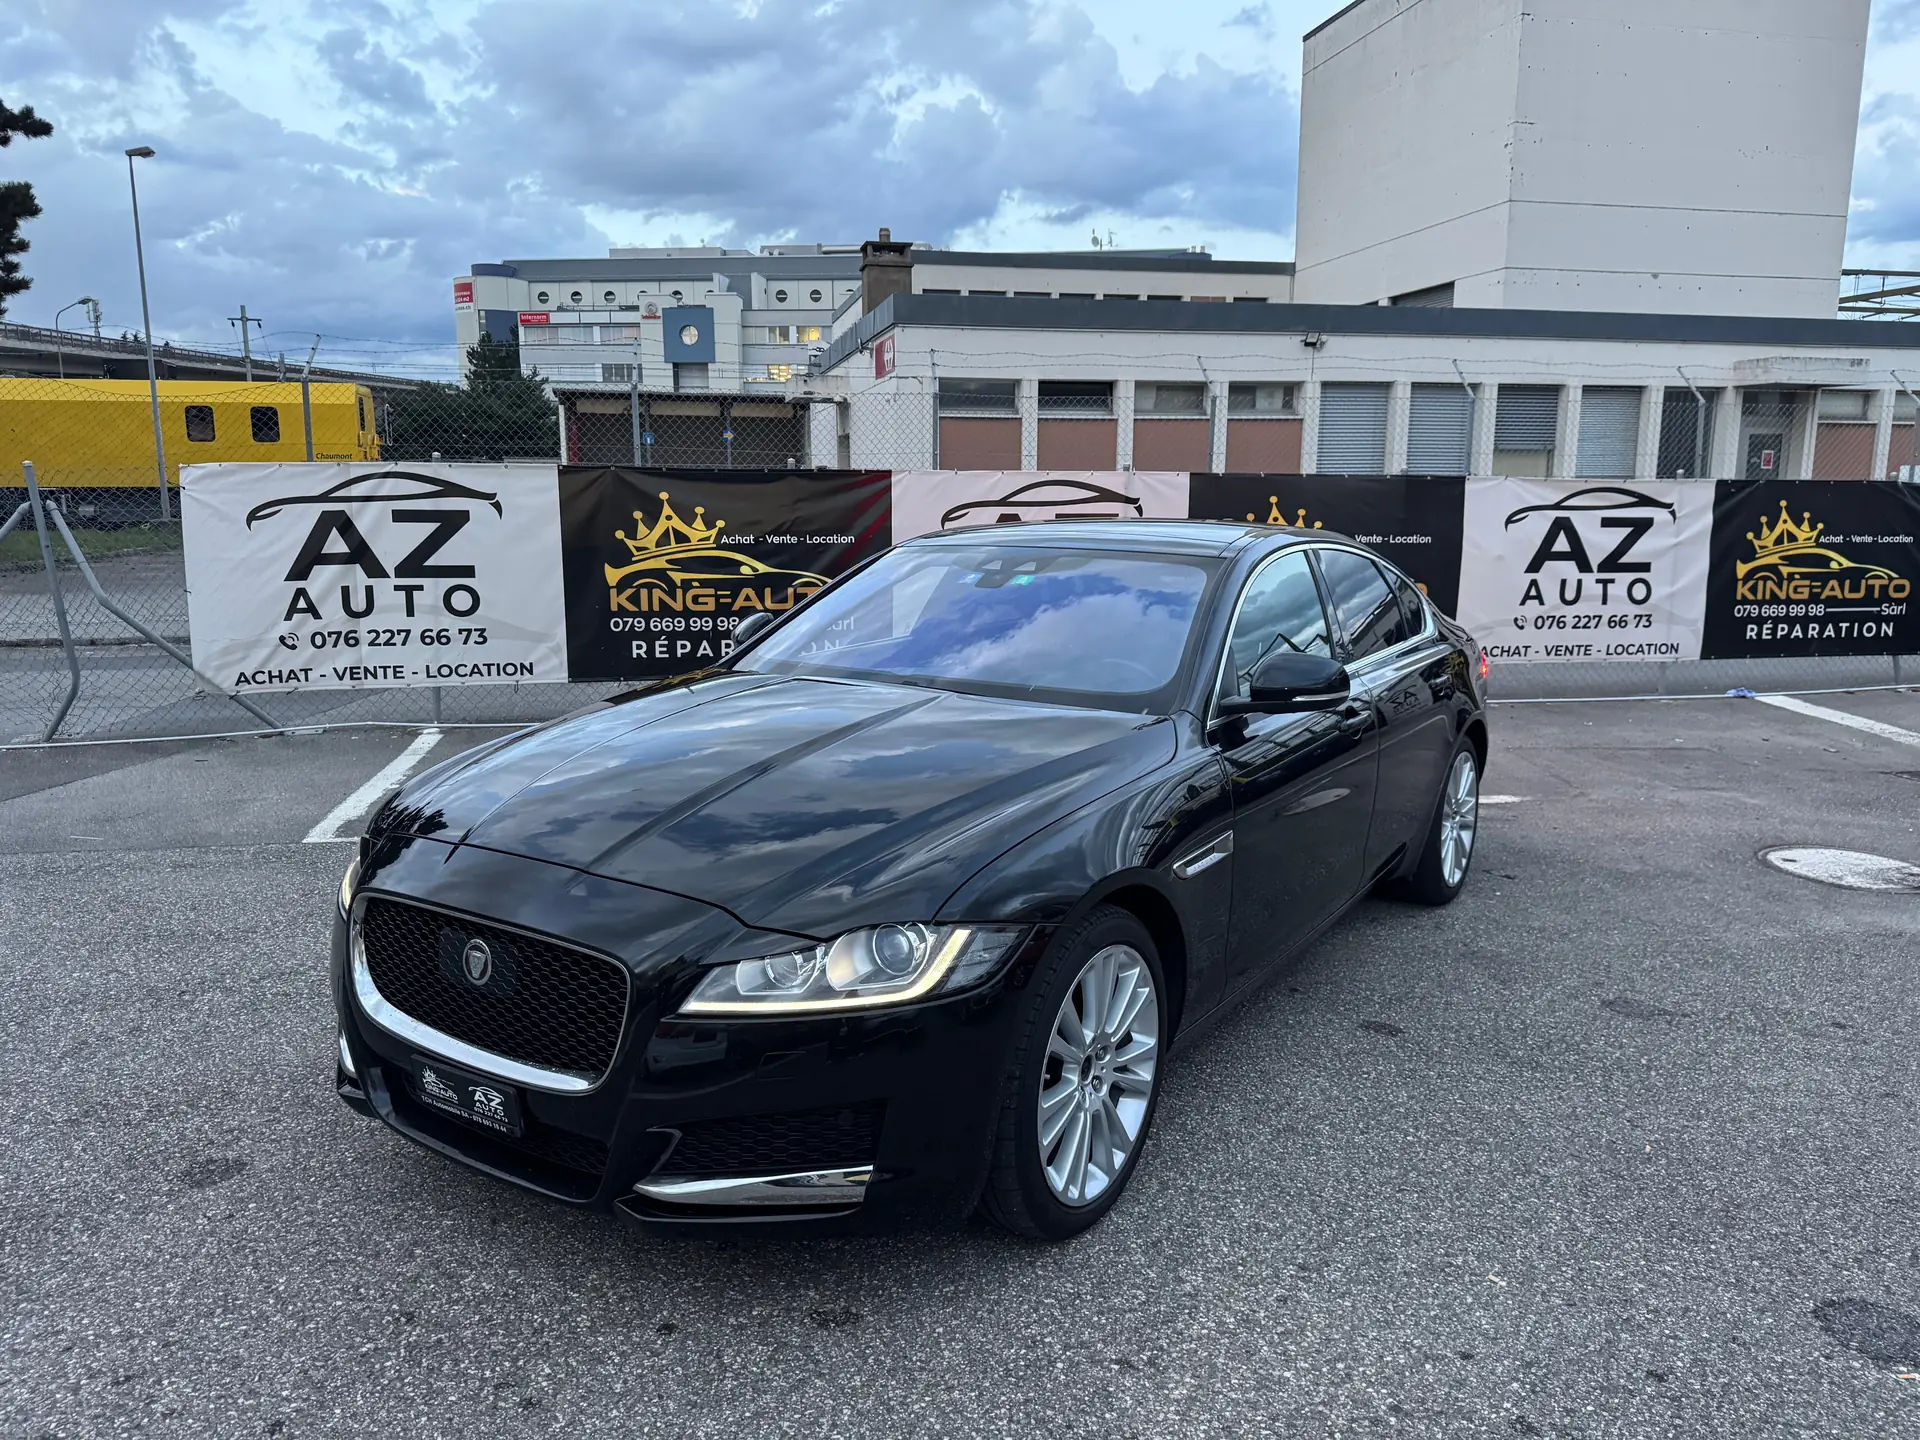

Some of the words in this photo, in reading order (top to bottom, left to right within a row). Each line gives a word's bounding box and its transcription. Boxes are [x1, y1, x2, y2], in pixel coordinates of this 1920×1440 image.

[315, 452, 353, 460] Chaumont
[284, 509, 476, 581] AZ
[721, 533, 755, 545] Achat
[765, 534, 798, 545] Vente
[806, 534, 855, 545] Location
[1355, 534, 1383, 543] Vente
[1390, 534, 1431, 543] Location
[1524, 516, 1654, 573] AZ
[1819, 534, 1843, 543] Achat
[1851, 535, 1873, 543] Vente
[1878, 535, 1914, 543] Location
[1519, 577, 1652, 606] AUTO
[283, 584, 481, 621] AUTO
[1734, 605, 1759, 618] 079
[1761, 605, 1787, 617] 669
[1789, 604, 1806, 616] 99
[1808, 604, 1825, 616] 98
[1881, 602, 1906, 616] Sàrl
[610, 617, 645, 632] 079
[649, 617, 686, 632] 669
[689, 617, 713, 632] 99
[717, 617, 740, 631] 98
[1534, 615, 1567, 630] 076
[1571, 615, 1602, 629] 227
[1607, 614, 1628, 629] 66
[1634, 614, 1652, 629] 73
[1746, 620, 1894, 640] RÉPARATION
[310, 629, 360, 650] 076
[367, 629, 411, 647] 227
[420, 628, 451, 646] 66
[457, 627, 488, 646] 73
[1481, 645, 1531, 657] ACHAT
[1544, 644, 1593, 657] VENTE
[1606, 643, 1679, 656] LOCATION
[234, 668, 313, 686] ACHAT
[333, 664, 405, 682] VENTE
[425, 662, 534, 679] LOCATION
[474, 1091, 504, 1110] AZ
[475, 1102, 504, 1116] AUTO
